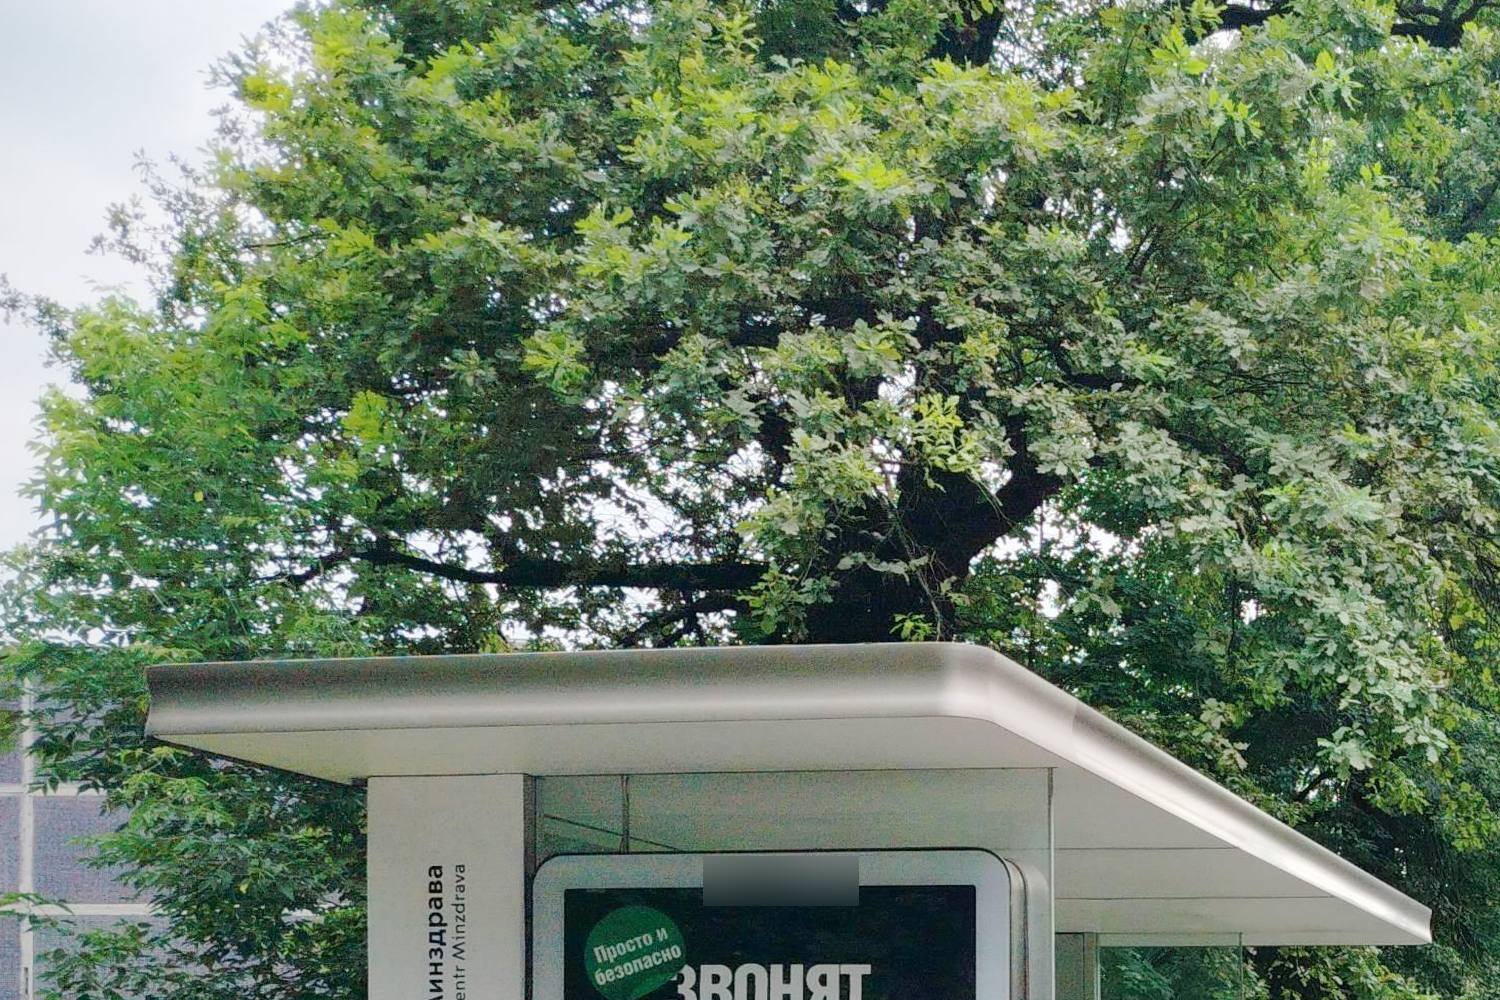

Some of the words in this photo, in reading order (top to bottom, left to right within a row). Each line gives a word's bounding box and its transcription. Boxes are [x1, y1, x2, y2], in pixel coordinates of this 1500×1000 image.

[451, 863, 467, 961] Minzdrava
[592, 933, 654, 964] Просто
[655, 927, 669, 942] и
[594, 944, 682, 986] безопасно
